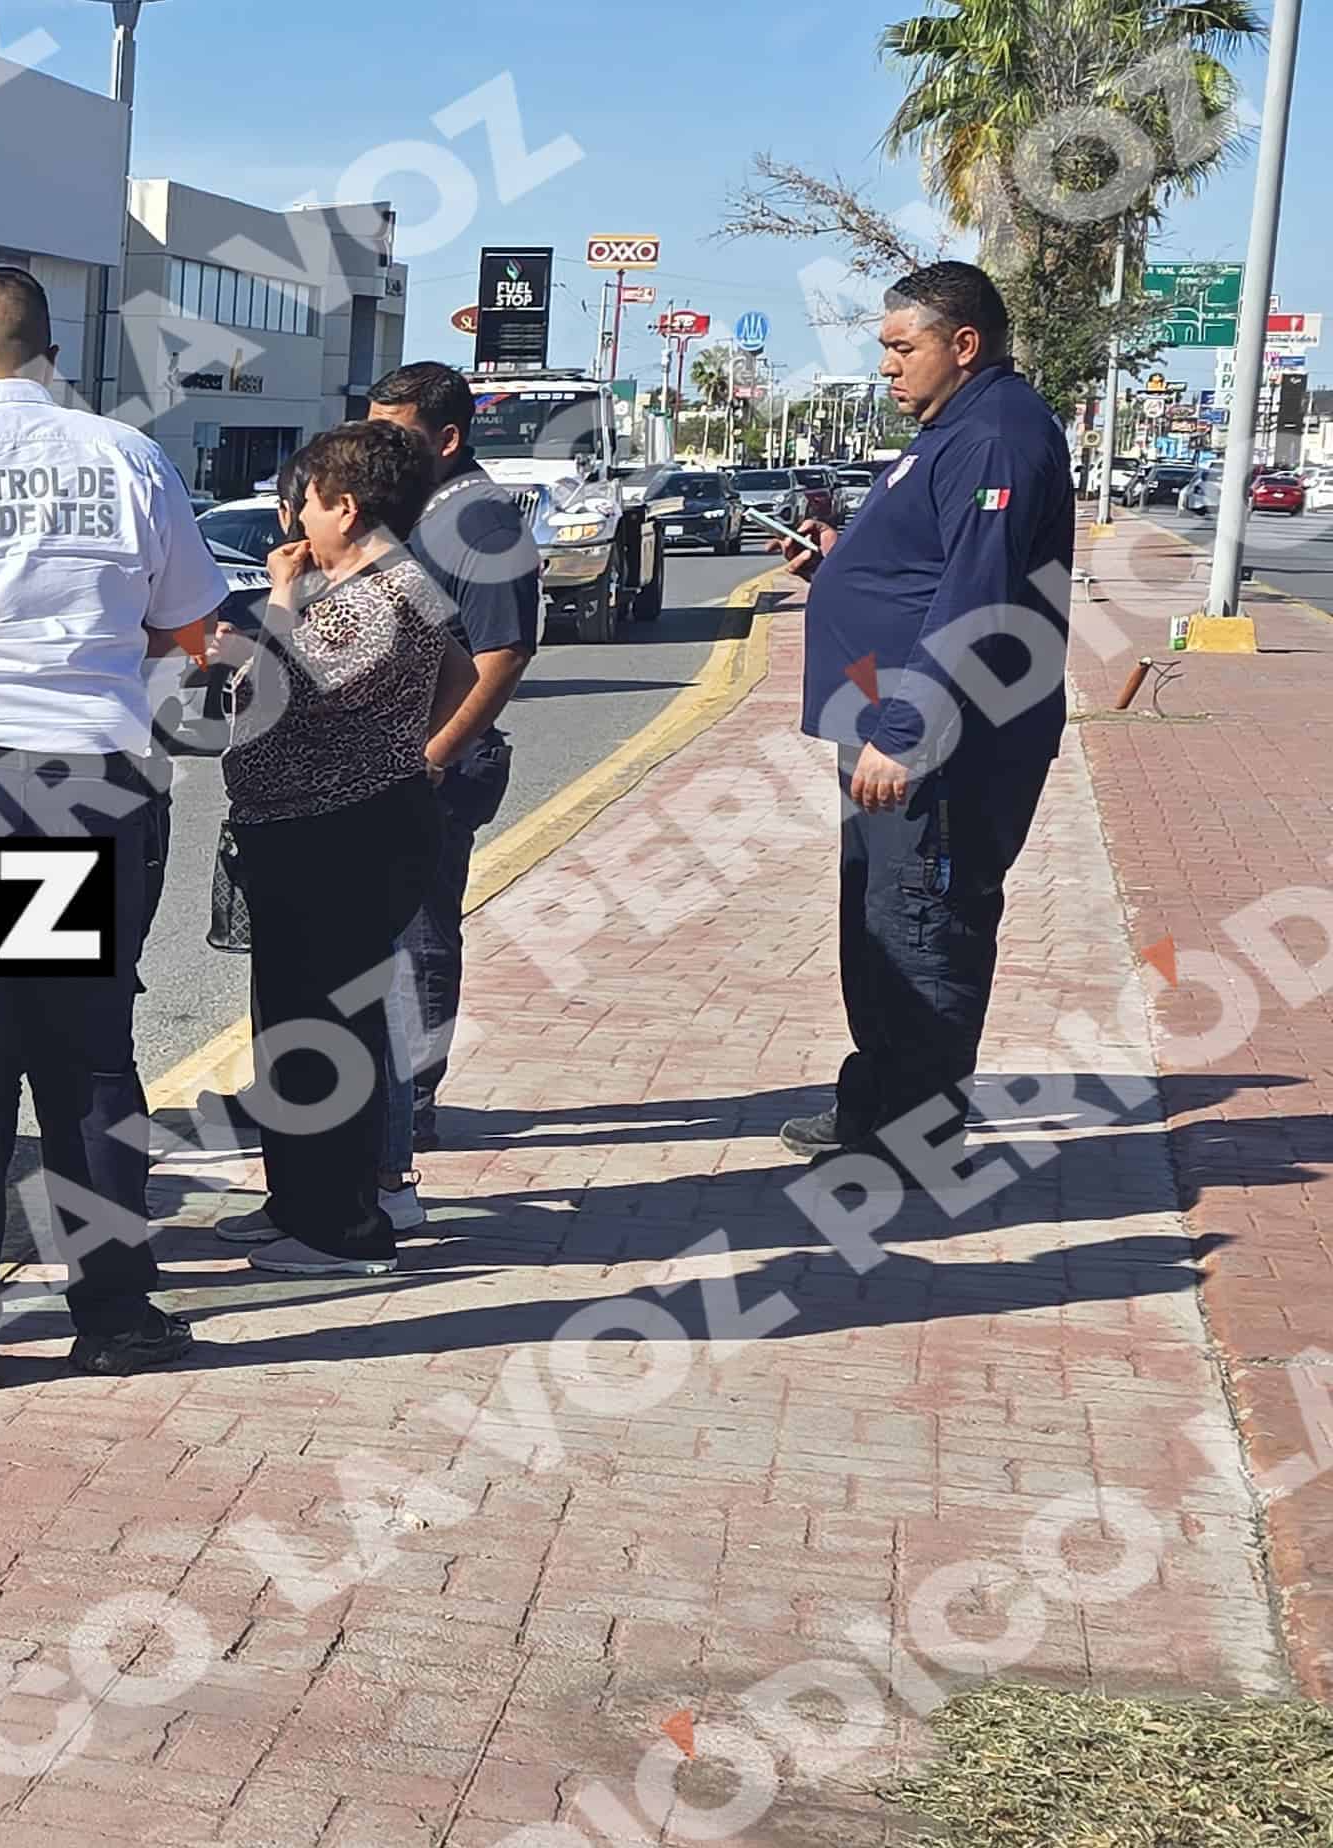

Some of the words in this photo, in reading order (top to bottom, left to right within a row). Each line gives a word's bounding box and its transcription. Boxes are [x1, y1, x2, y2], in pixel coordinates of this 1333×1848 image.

[589, 242, 657, 262] OXXO
[496, 281, 532, 296] FUEL
[495, 293, 533, 307] STOP
[77, 467, 116, 499] DE
